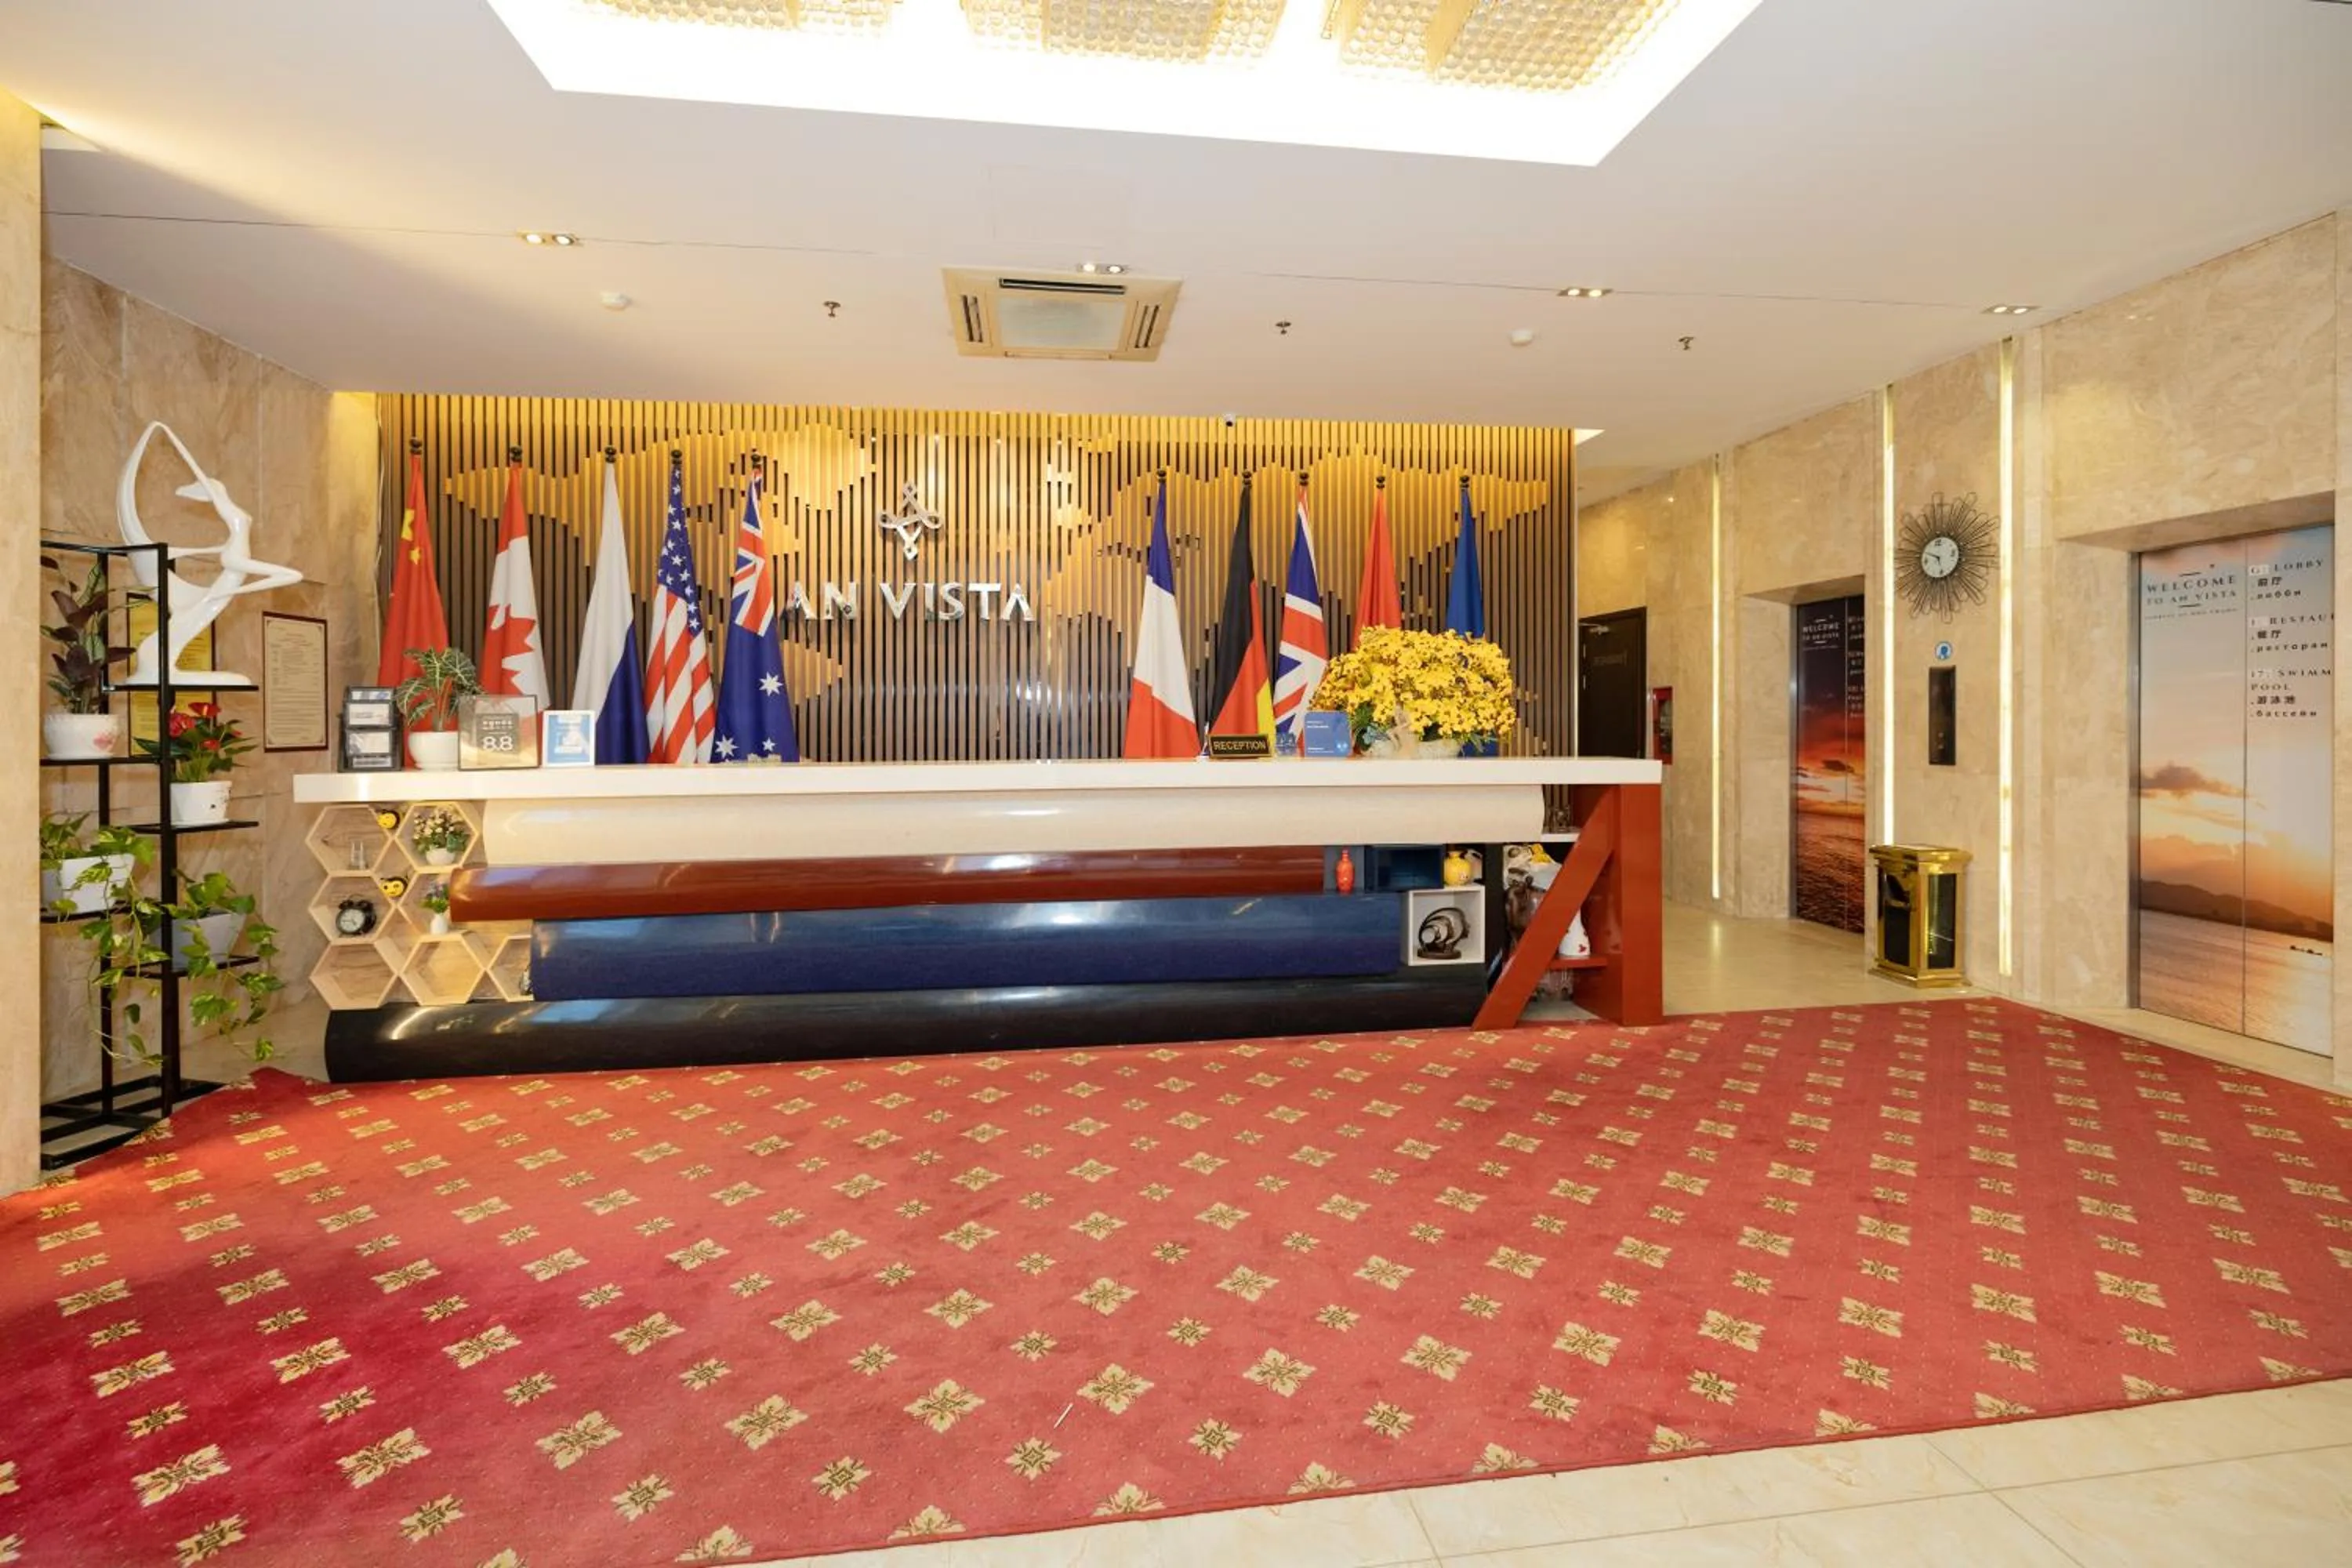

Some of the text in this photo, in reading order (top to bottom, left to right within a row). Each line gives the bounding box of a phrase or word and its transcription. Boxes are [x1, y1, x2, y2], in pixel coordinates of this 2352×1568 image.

[2274, 559, 2324, 572] LOBBY
[2147, 575, 2237, 593] WELCOME
[781, 581, 1036, 621] AN VISTA
[2195, 590, 2237, 601] VISTA
[2251, 682, 2289, 691] POOL
[1213, 740, 1266, 750] RECEPTION
